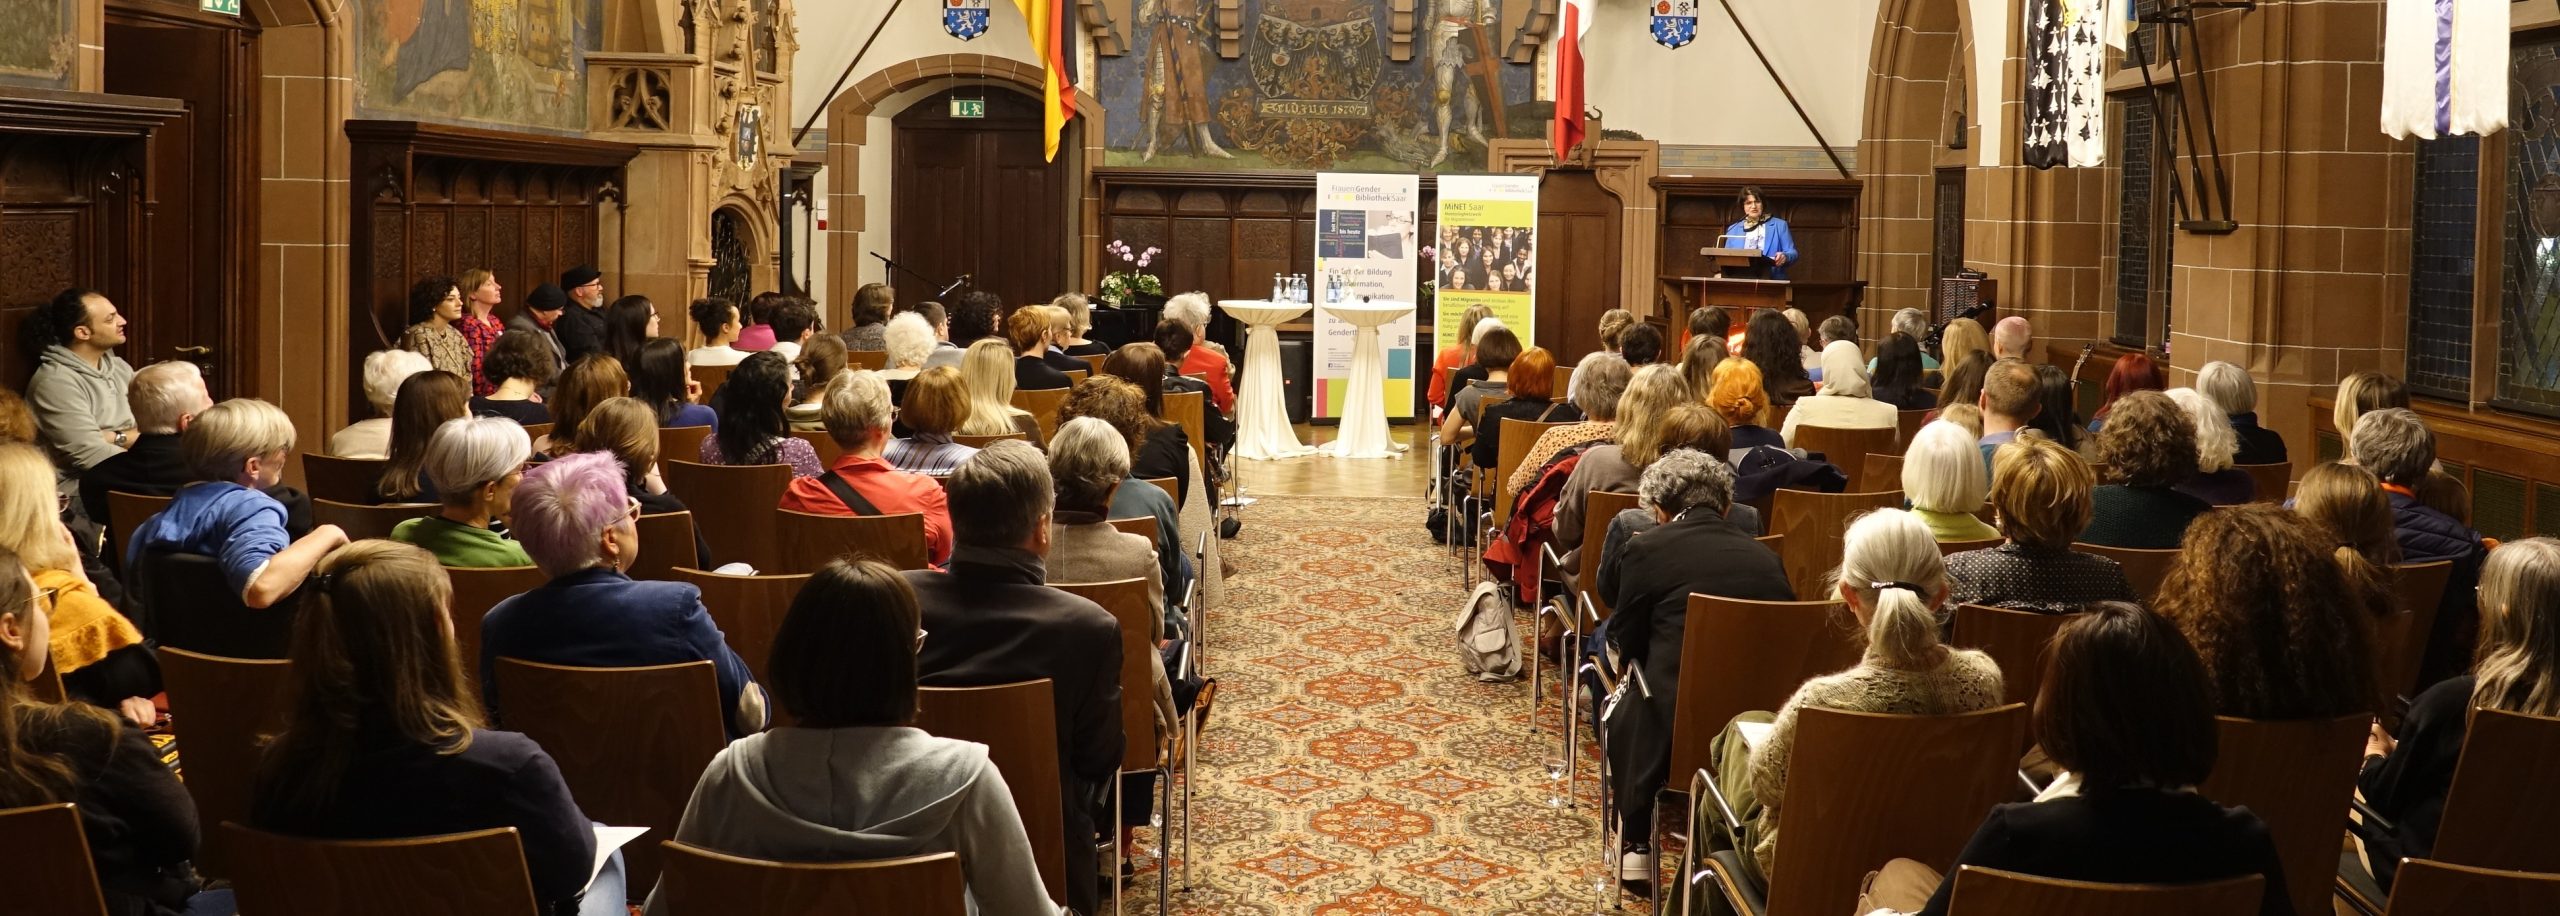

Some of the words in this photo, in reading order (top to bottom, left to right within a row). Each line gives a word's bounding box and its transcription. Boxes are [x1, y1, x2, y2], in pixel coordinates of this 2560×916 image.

[1331, 104, 1368, 116] 1870/71
[1444, 203, 1466, 211] MiNET
[1469, 203, 1484, 211] Saar
[1367, 268, 1392, 277] Bildung
